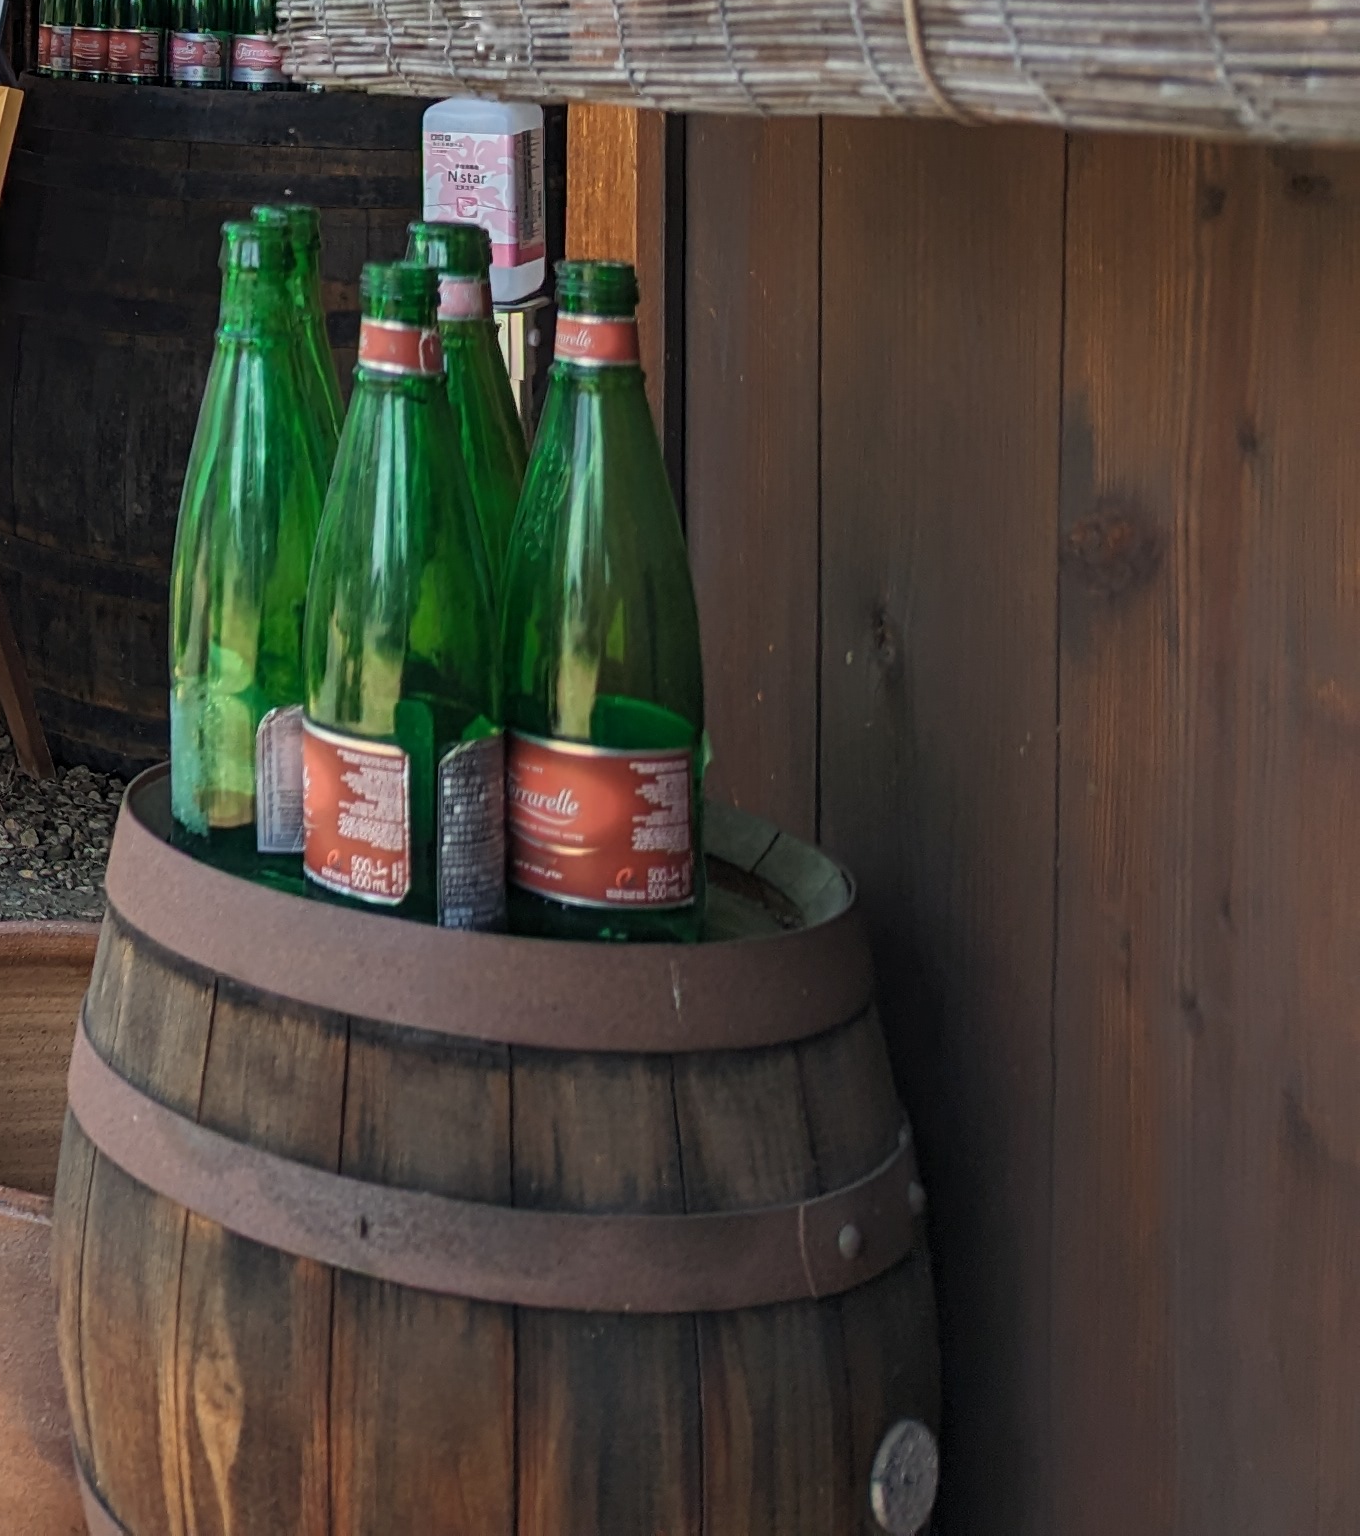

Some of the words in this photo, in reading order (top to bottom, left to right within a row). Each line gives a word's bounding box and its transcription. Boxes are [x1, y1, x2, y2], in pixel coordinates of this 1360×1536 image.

[351, 854, 371, 873] 500
[351, 871, 371, 889] 500
[372, 878, 390, 894] mL
[647, 883, 667, 900] 500
